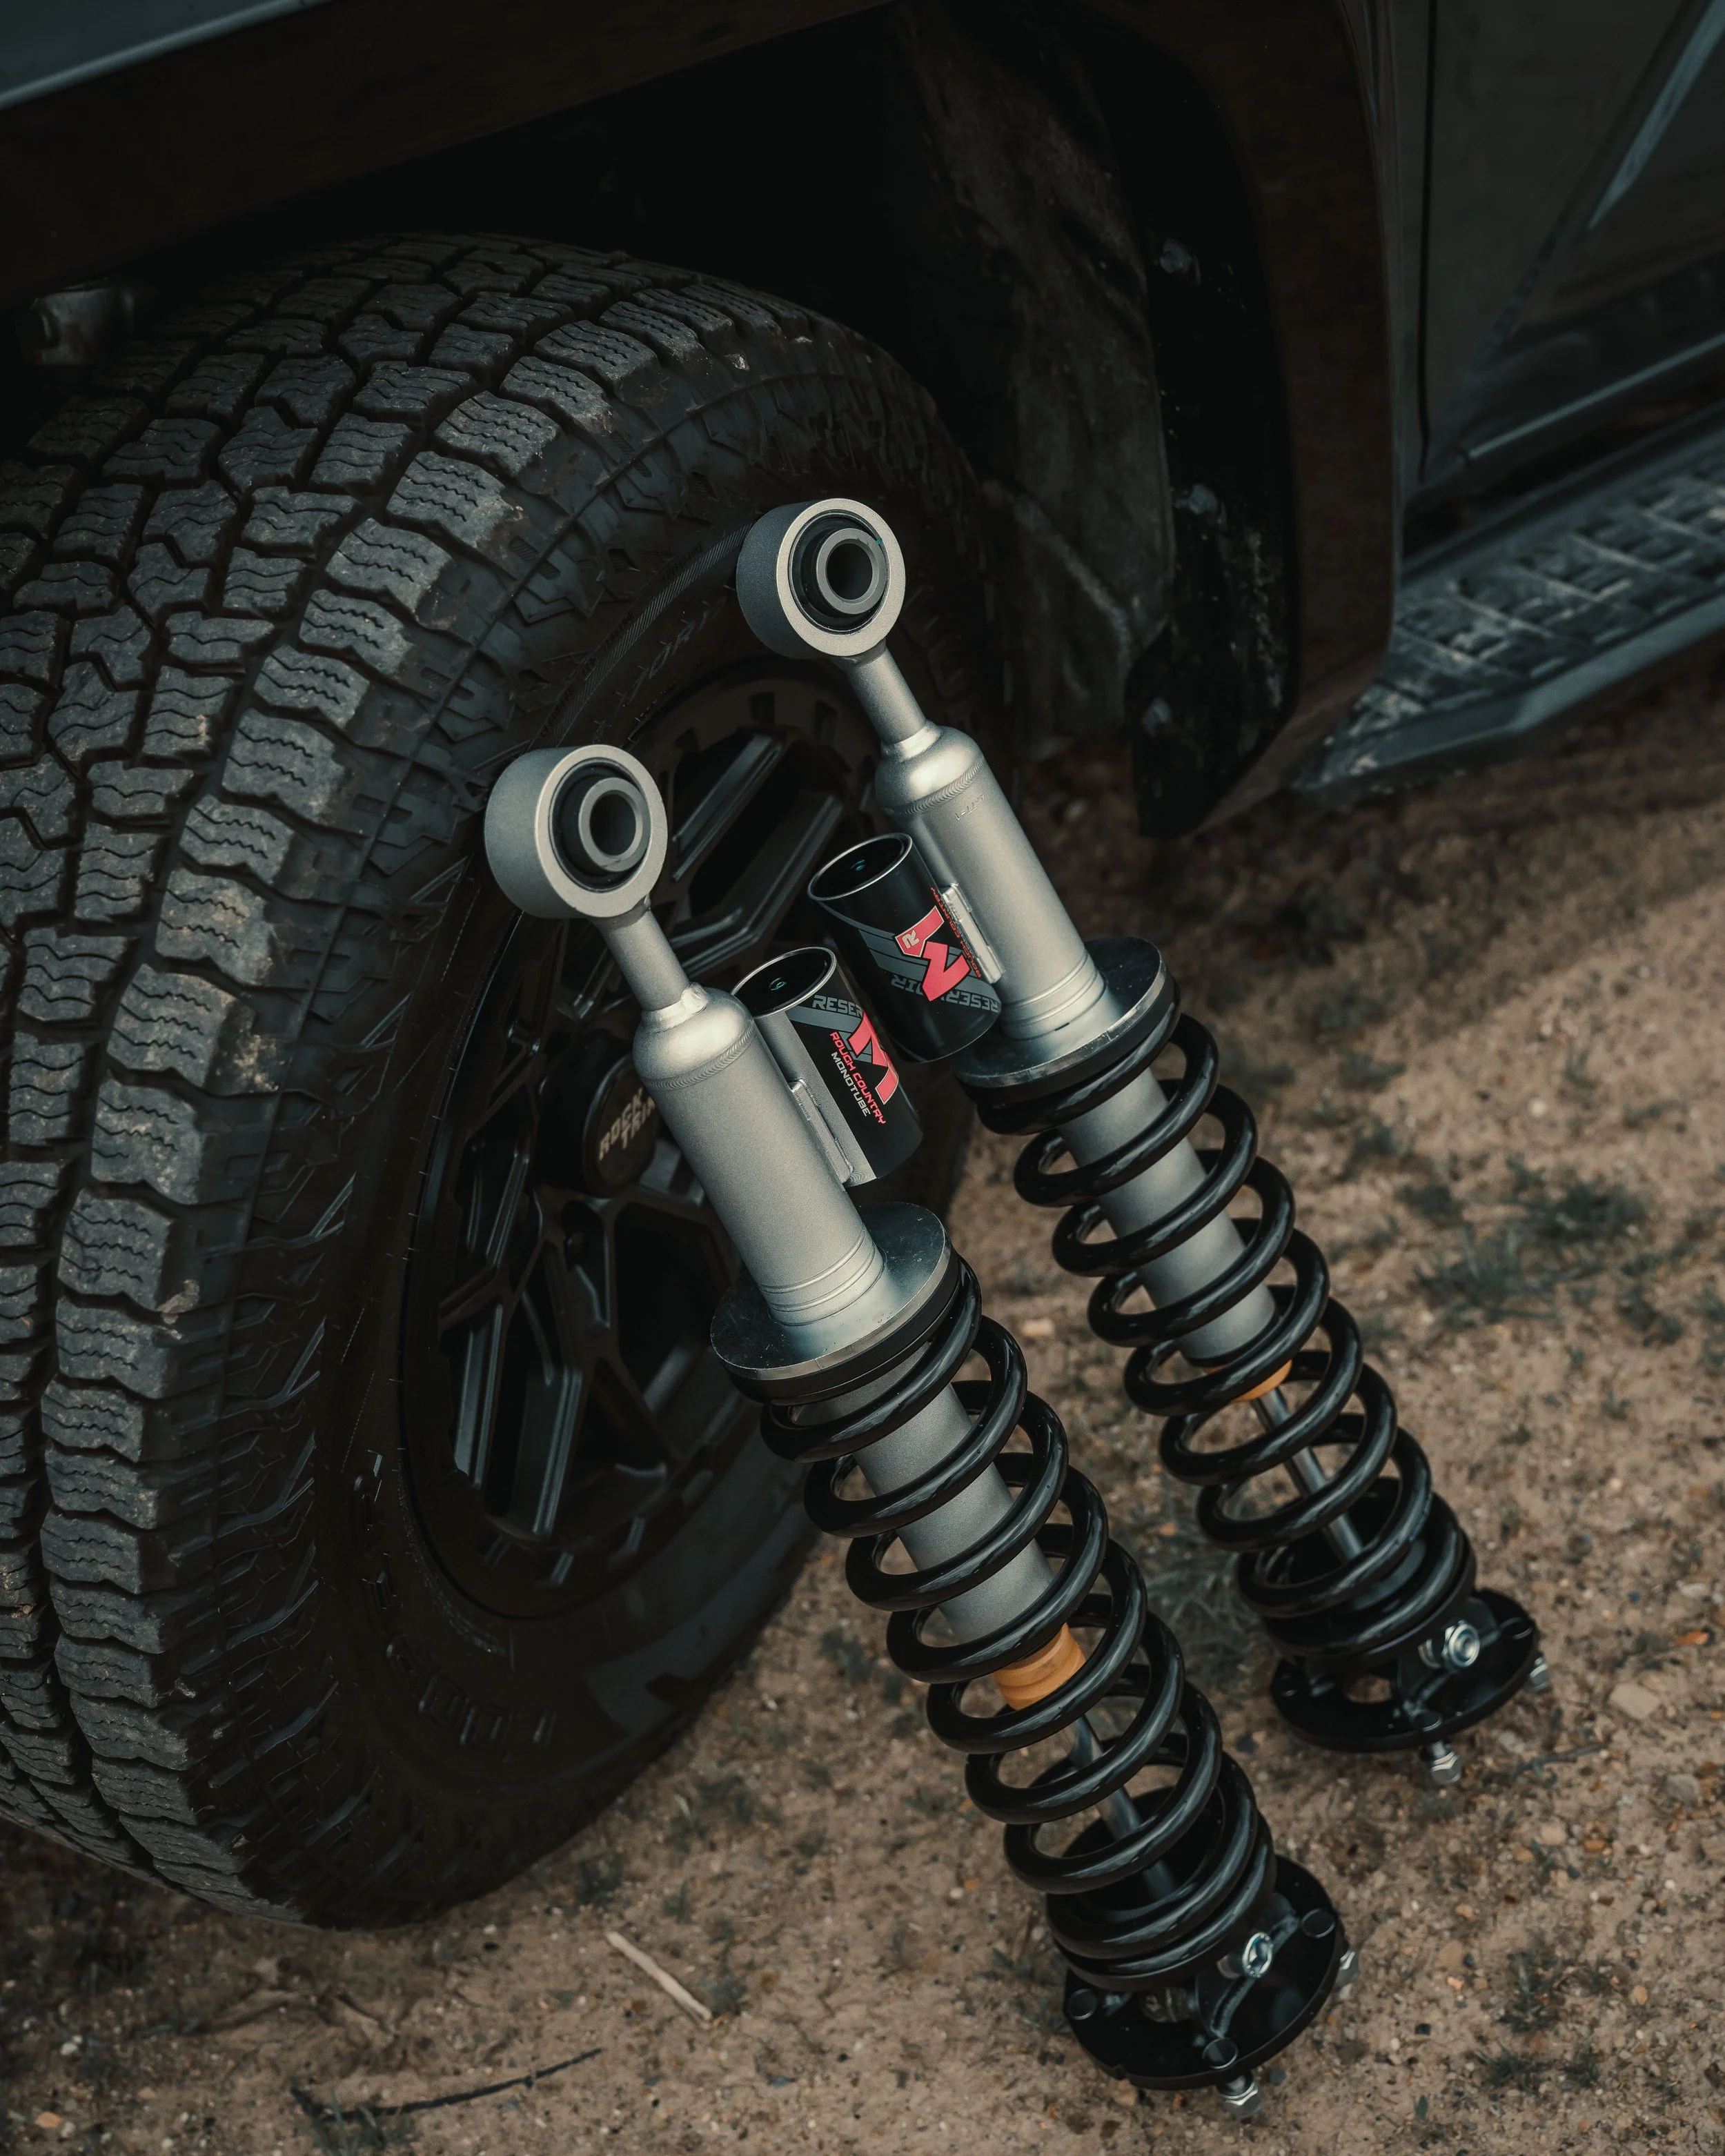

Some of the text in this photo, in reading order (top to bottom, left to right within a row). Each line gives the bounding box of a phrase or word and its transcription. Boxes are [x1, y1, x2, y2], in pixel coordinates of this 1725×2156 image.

[830, 1031, 887, 1125] ROUGH COUNTRY
[831, 1051, 871, 1117] MONOTUBE
